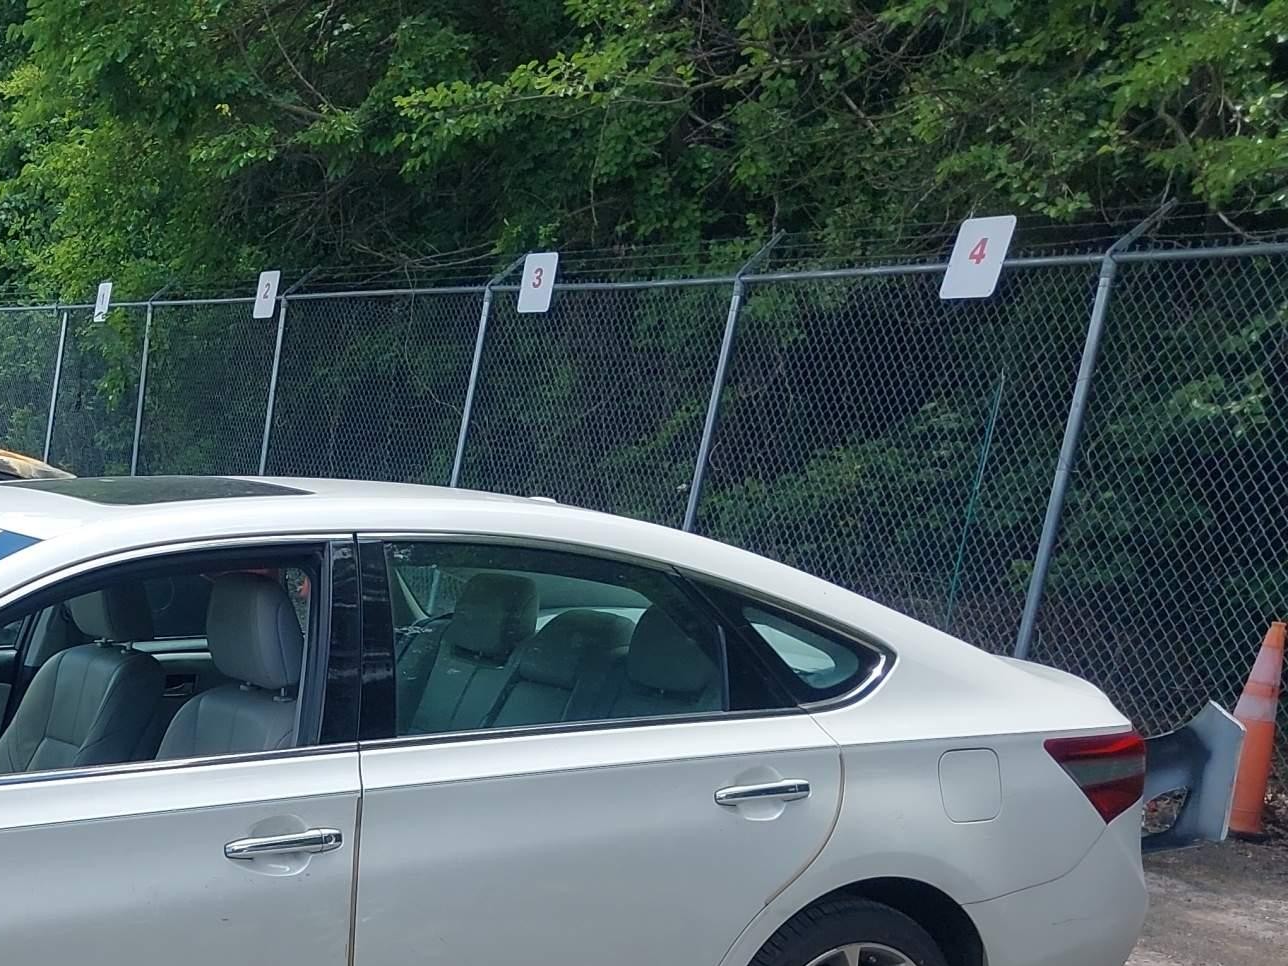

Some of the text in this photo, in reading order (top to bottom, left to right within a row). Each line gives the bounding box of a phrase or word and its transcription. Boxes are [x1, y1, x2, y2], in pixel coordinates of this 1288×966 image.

[968, 237, 988, 265] 4
[532, 267, 544, 289] 3
[262, 282, 271, 300] 2
